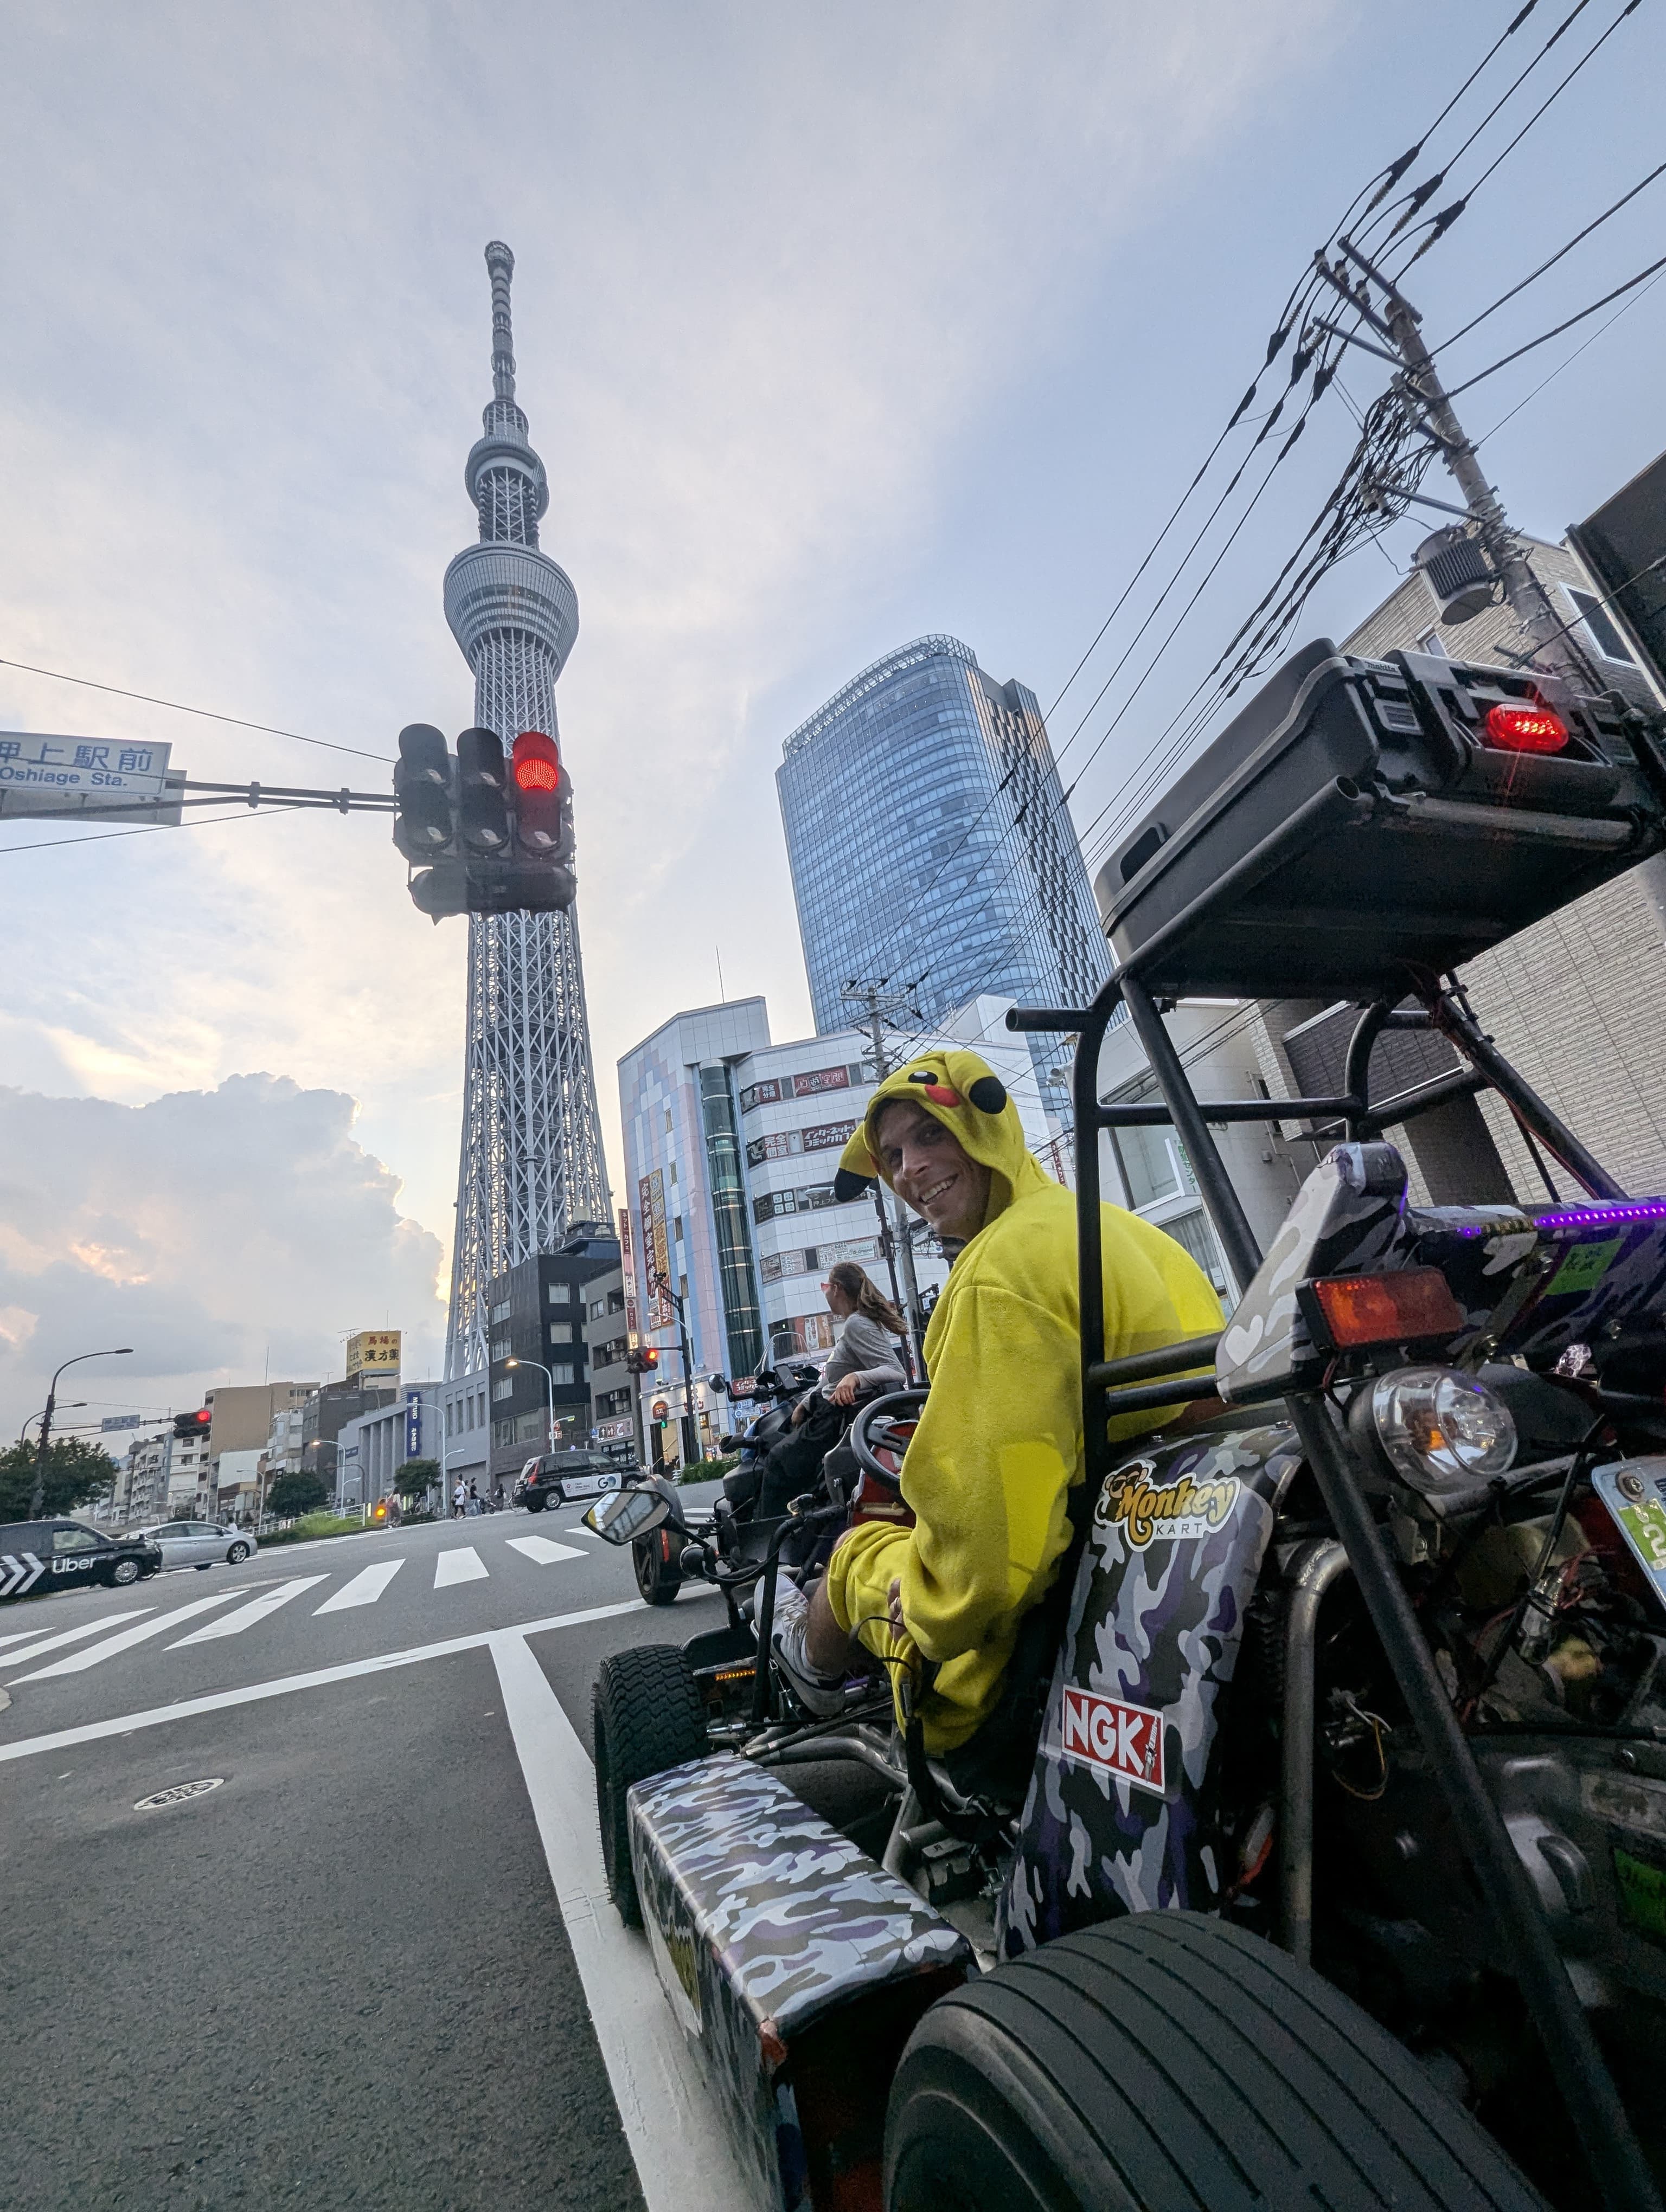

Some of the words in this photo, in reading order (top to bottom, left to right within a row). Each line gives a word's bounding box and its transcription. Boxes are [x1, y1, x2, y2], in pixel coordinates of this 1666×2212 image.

[0, 767, 80, 785] Oshiage
[91, 772, 127, 786] Sta.
[765, 1134, 786, 1148] 完全
[766, 1145, 788, 1159] 個室
[368, 1336, 398, 1345] 馬場の
[364, 1348, 399, 1361] 漢方薬
[598, 1476, 617, 1489] GO
[1114, 1476, 1236, 1544] Monkey
[1156, 1522, 1203, 1536] KART
[53, 1557, 97, 1573] Uber
[1066, 1695, 1144, 1776] NGK
